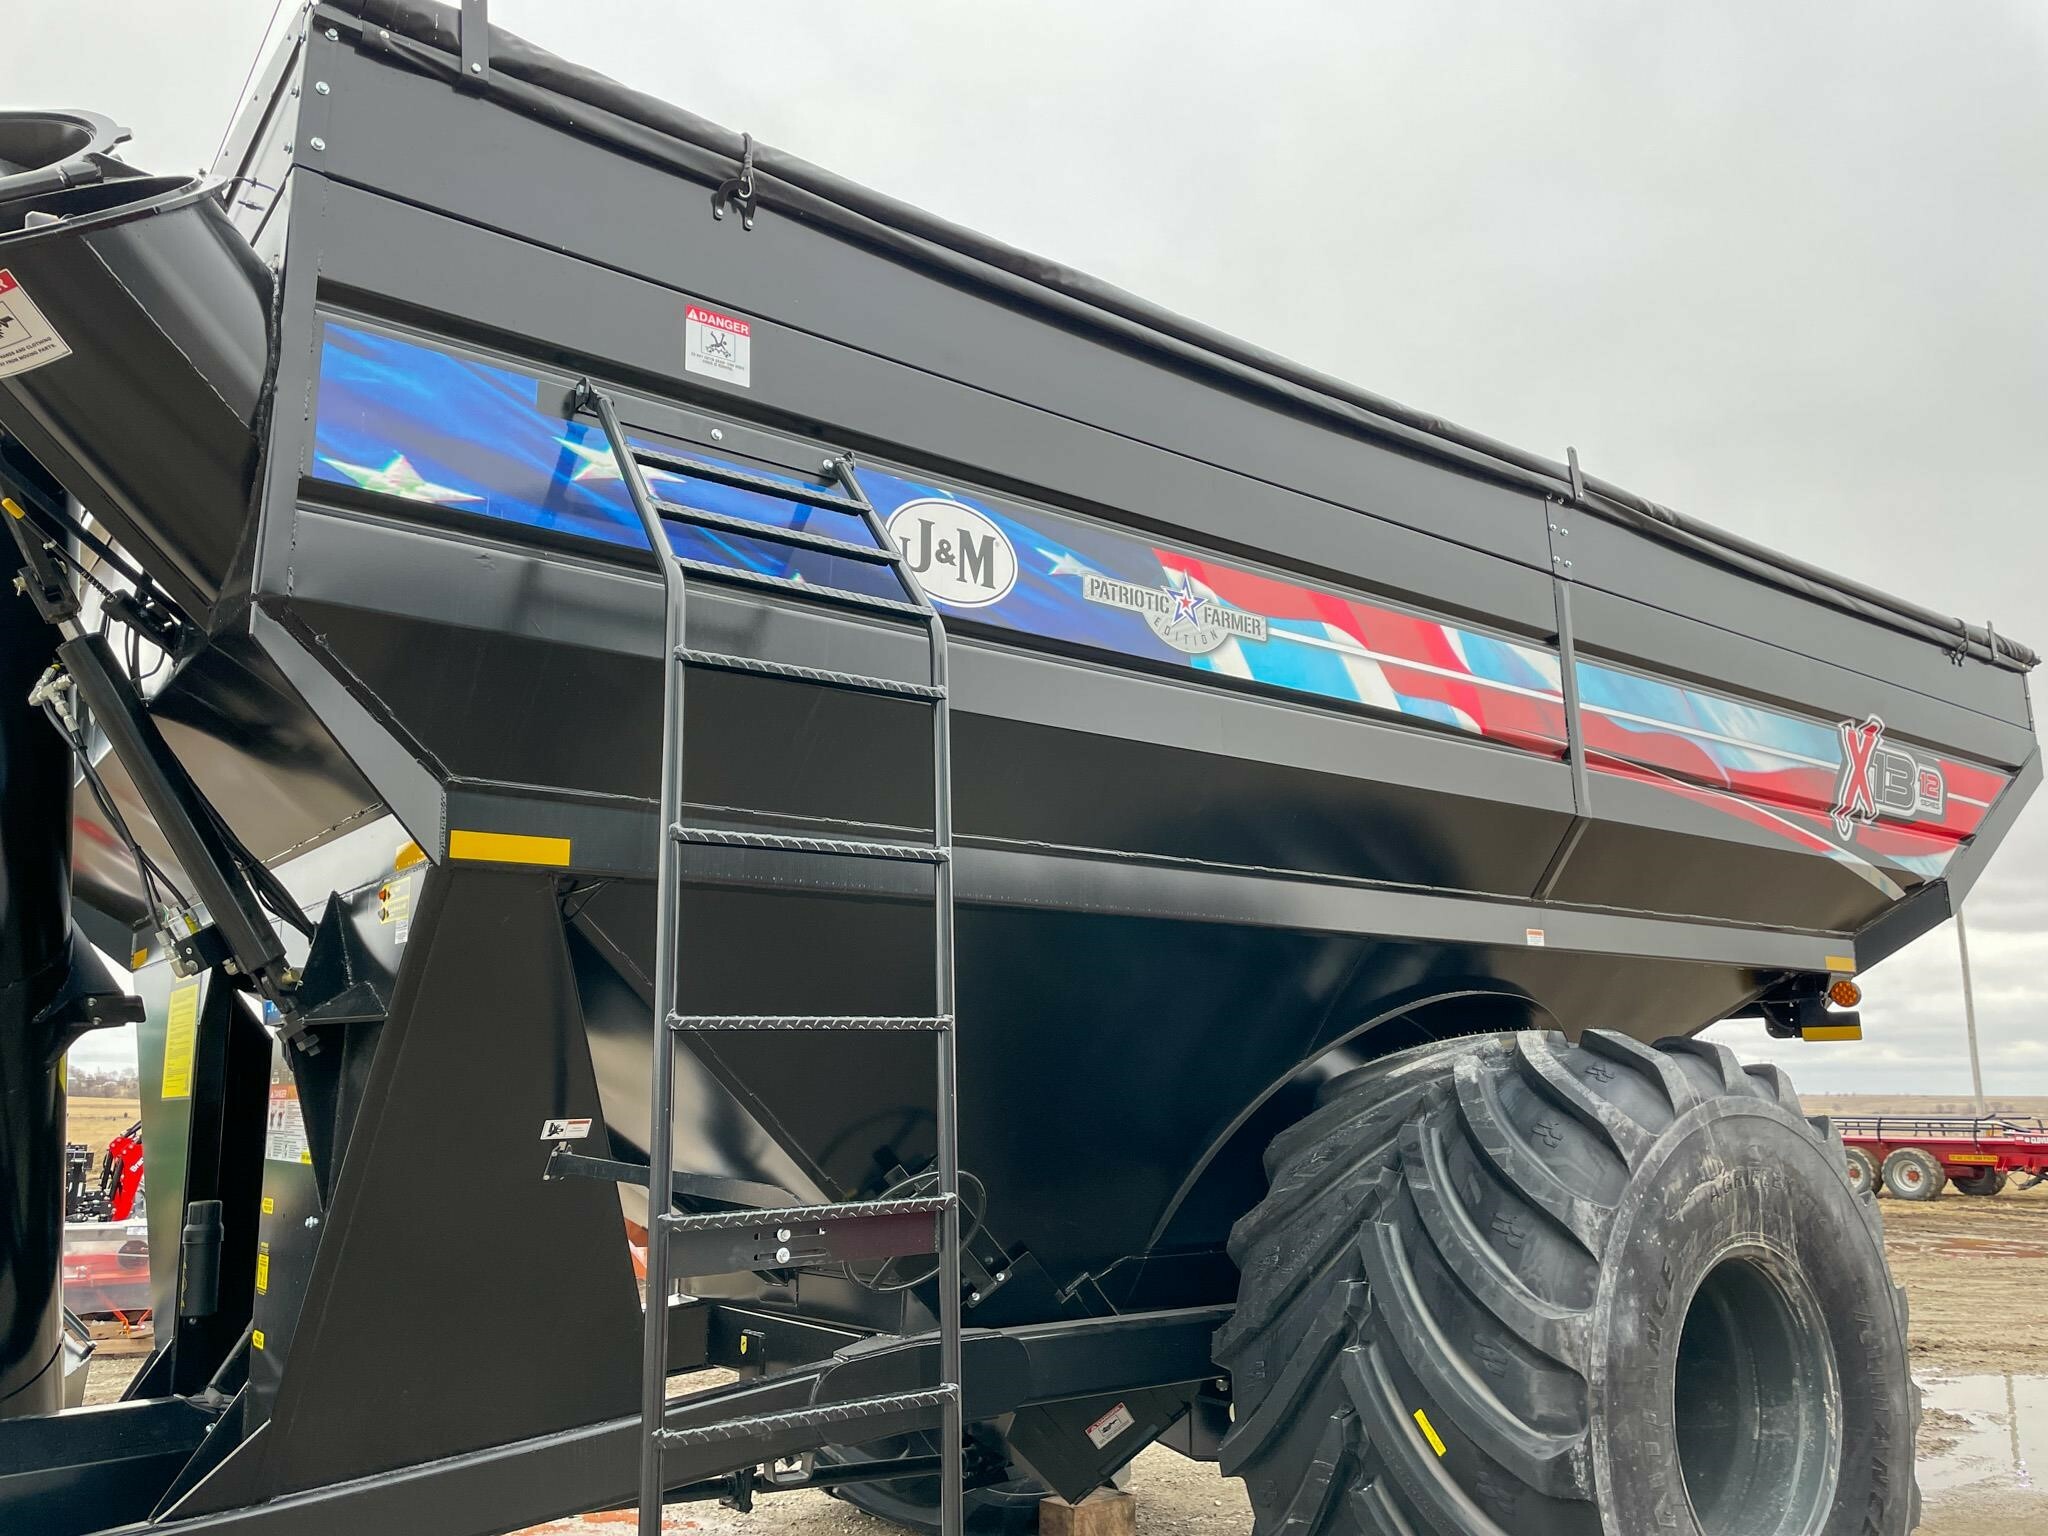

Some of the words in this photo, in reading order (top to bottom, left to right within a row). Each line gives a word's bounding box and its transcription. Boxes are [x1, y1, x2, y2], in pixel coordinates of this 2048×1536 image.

[699, 311, 749, 335] DANGER
[899, 518, 996, 590] J&M
[1090, 578, 1170, 614] PATRIOTIC
[1204, 606, 1262, 636] FARMER
[1154, 616, 1218, 646] EDITION
